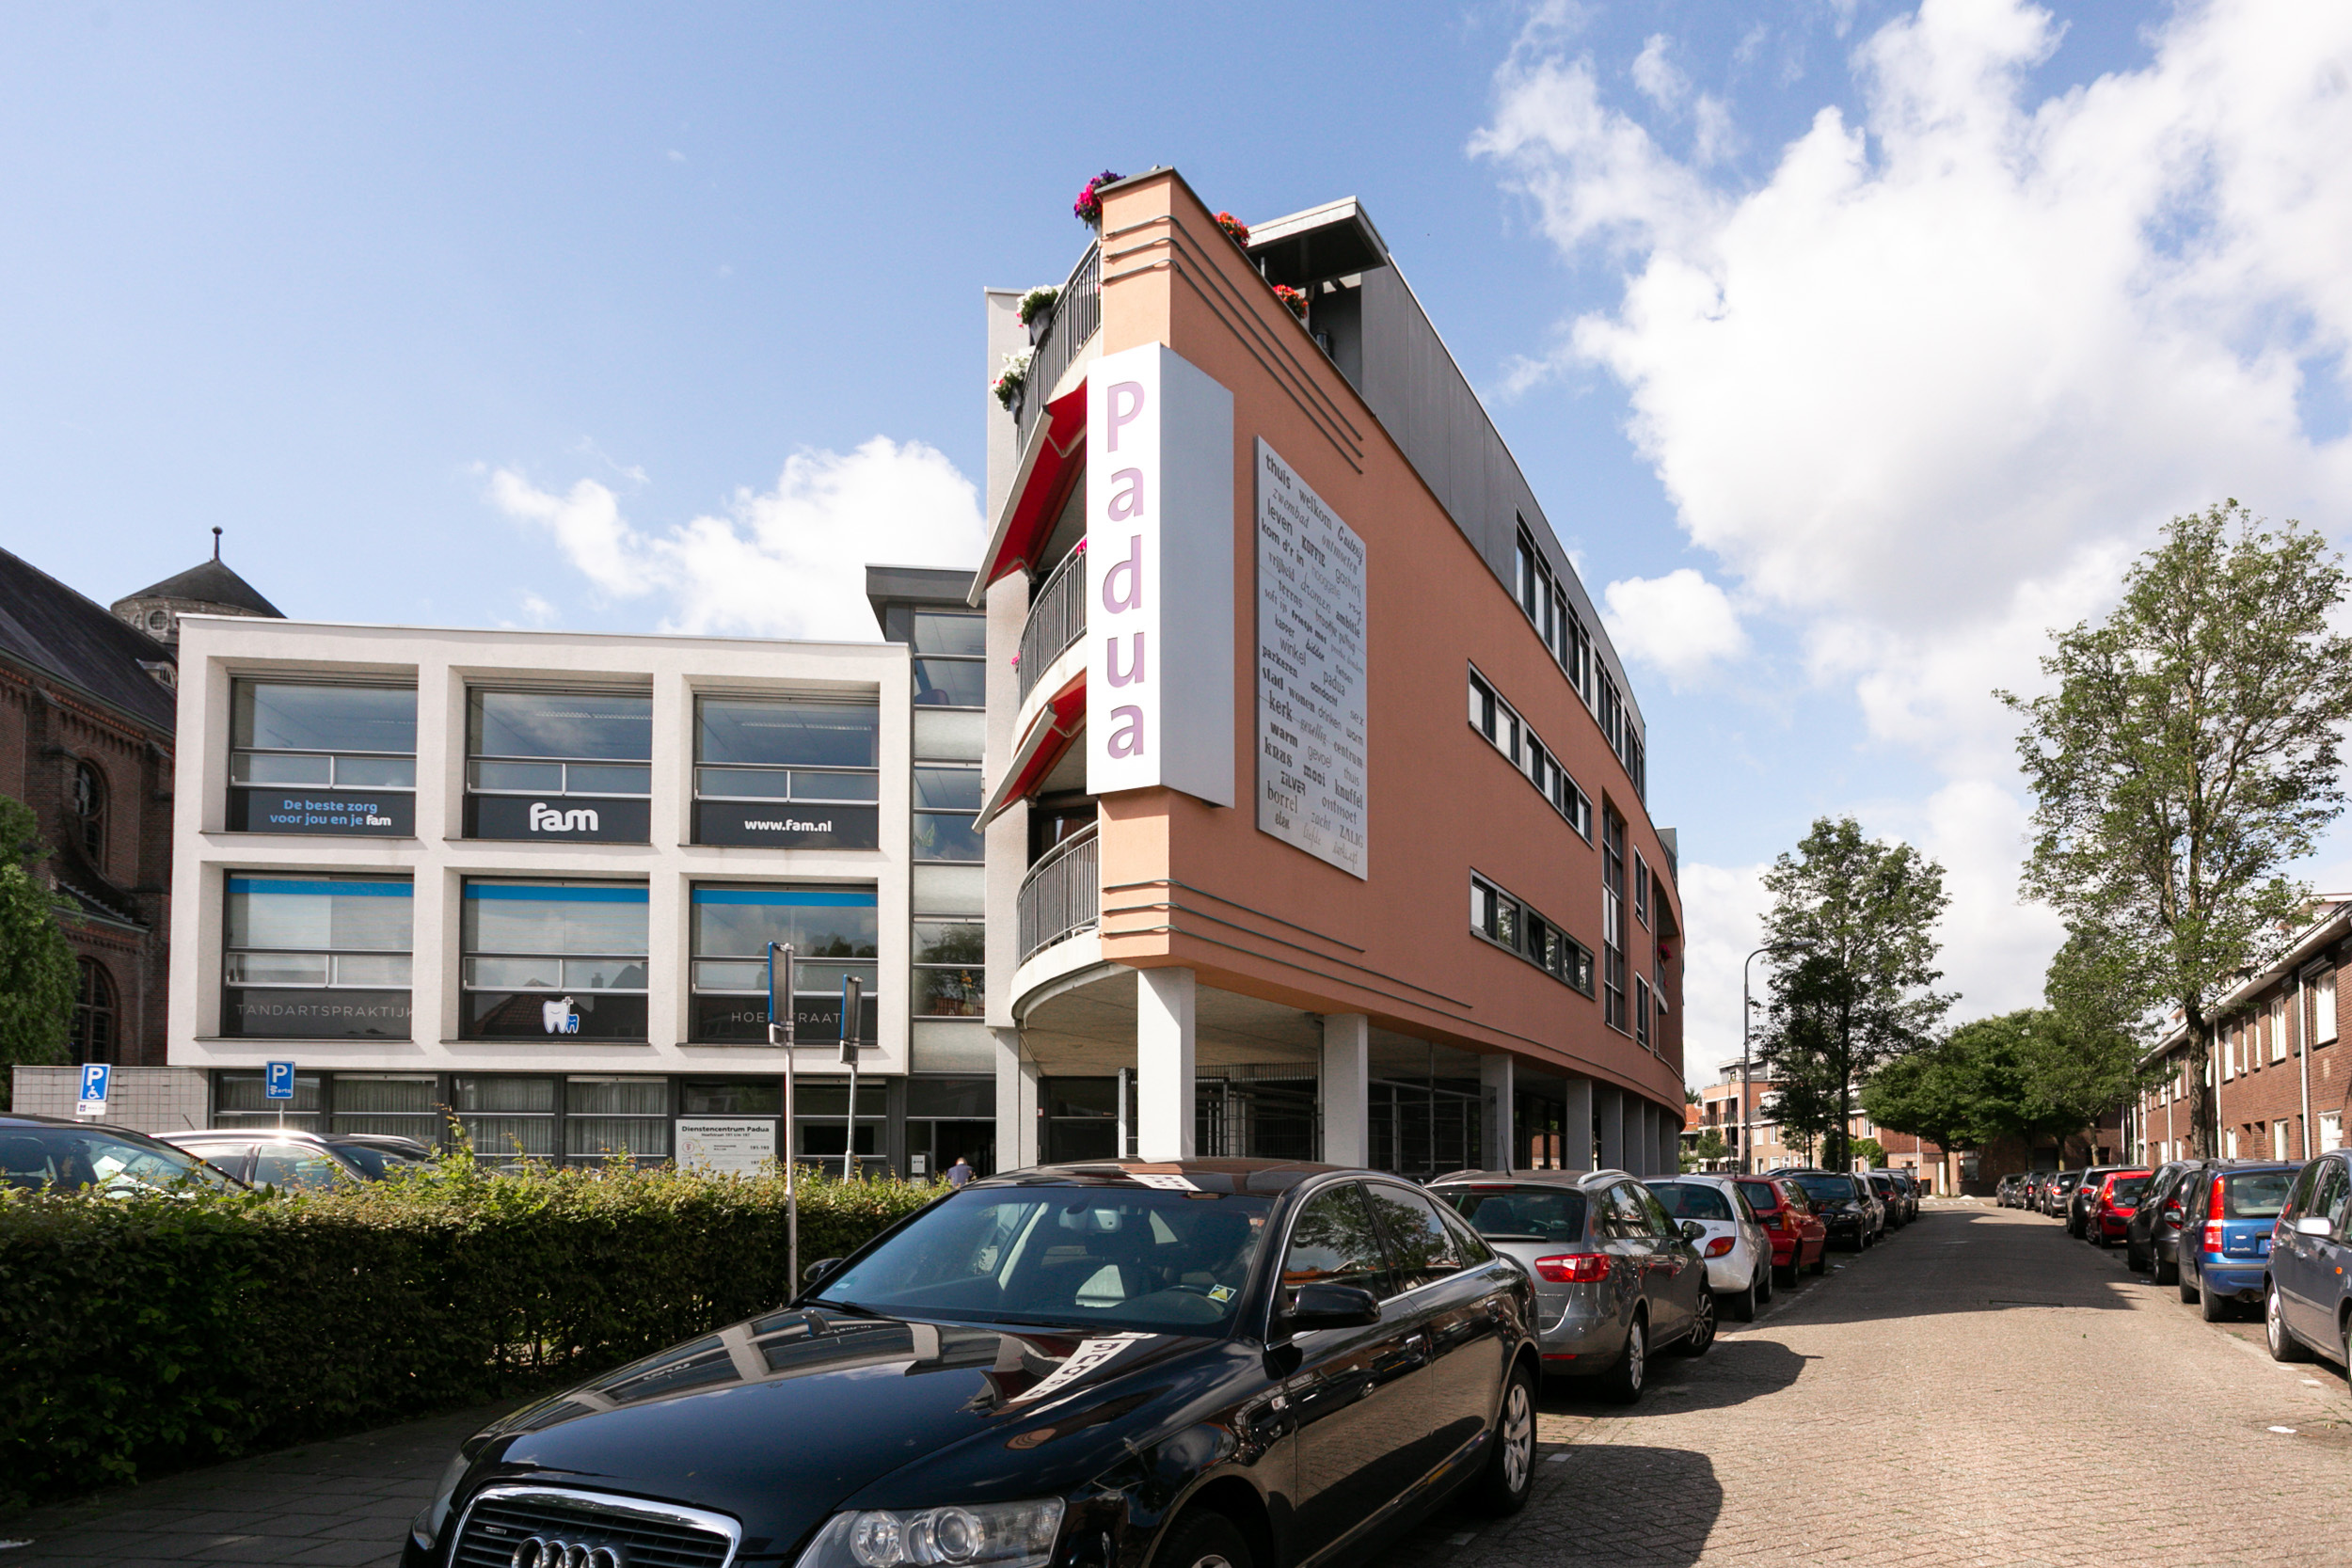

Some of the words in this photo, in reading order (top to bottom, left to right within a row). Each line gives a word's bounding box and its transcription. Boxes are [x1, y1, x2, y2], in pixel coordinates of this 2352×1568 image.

[1266, 454, 1291, 489] thuis
[1298, 489, 1331, 531] welkom
[1262, 517, 1279, 546] kom
[1283, 539, 1294, 557] d'r
[1296, 549, 1304, 567] in
[1268, 499, 1293, 536] leven
[1302, 535, 1325, 568] KOFFIE
[1336, 568, 1360, 602] gastvrij
[1272, 489, 1310, 529] zwembad
[1322, 534, 1358, 575] ontmoeten
[1103, 381, 1145, 759] Padua
[1268, 551, 1295, 582] vrijheid
[1300, 572, 1331, 613] dromen
[1336, 611, 1360, 638] ambitie
[1279, 579, 1302, 608] terras
[1264, 589, 1278, 605] soft
[1292, 610, 1312, 633] frietje
[1315, 630, 1327, 644] met
[1279, 637, 1306, 666] winkel
[1324, 672, 1345, 696] padua
[1306, 639, 1325, 662] bidden
[1263, 645, 1298, 678] parkeren
[1350, 710, 1364, 726] sex
[1263, 668, 1283, 690] stad
[1289, 687, 1315, 713] wonen
[1319, 705, 1342, 732] drinken
[1269, 690, 1293, 722] kerk
[1300, 719, 1327, 747] gezellig
[1334, 741, 1362, 768] centrum
[1270, 722, 1298, 748] warm
[1308, 745, 1332, 768] gevoel
[1344, 768, 1359, 786] thuis
[1264, 736, 1293, 768] knus
[1304, 764, 1326, 787] mooi
[1335, 779, 1362, 810] knuffel
[270, 815, 302, 824] voor
[305, 813, 326, 826] jou
[330, 816, 347, 825] en
[350, 815, 363, 827] je
[366, 815, 391, 826] fam
[283, 800, 302, 810] De
[305, 800, 344, 812] beste
[347, 802, 377, 814] zorg
[530, 802, 598, 832] fam
[745, 818, 832, 832] www.fam.nl
[1268, 781, 1298, 814] borrel
[1311, 813, 1330, 832] zacht
[1340, 824, 1363, 848] ZALIG
[1276, 811, 1290, 830] eten
[1322, 797, 1357, 824] ontmoet
[87, 1067, 103, 1086] P
[273, 1064, 288, 1083] P
